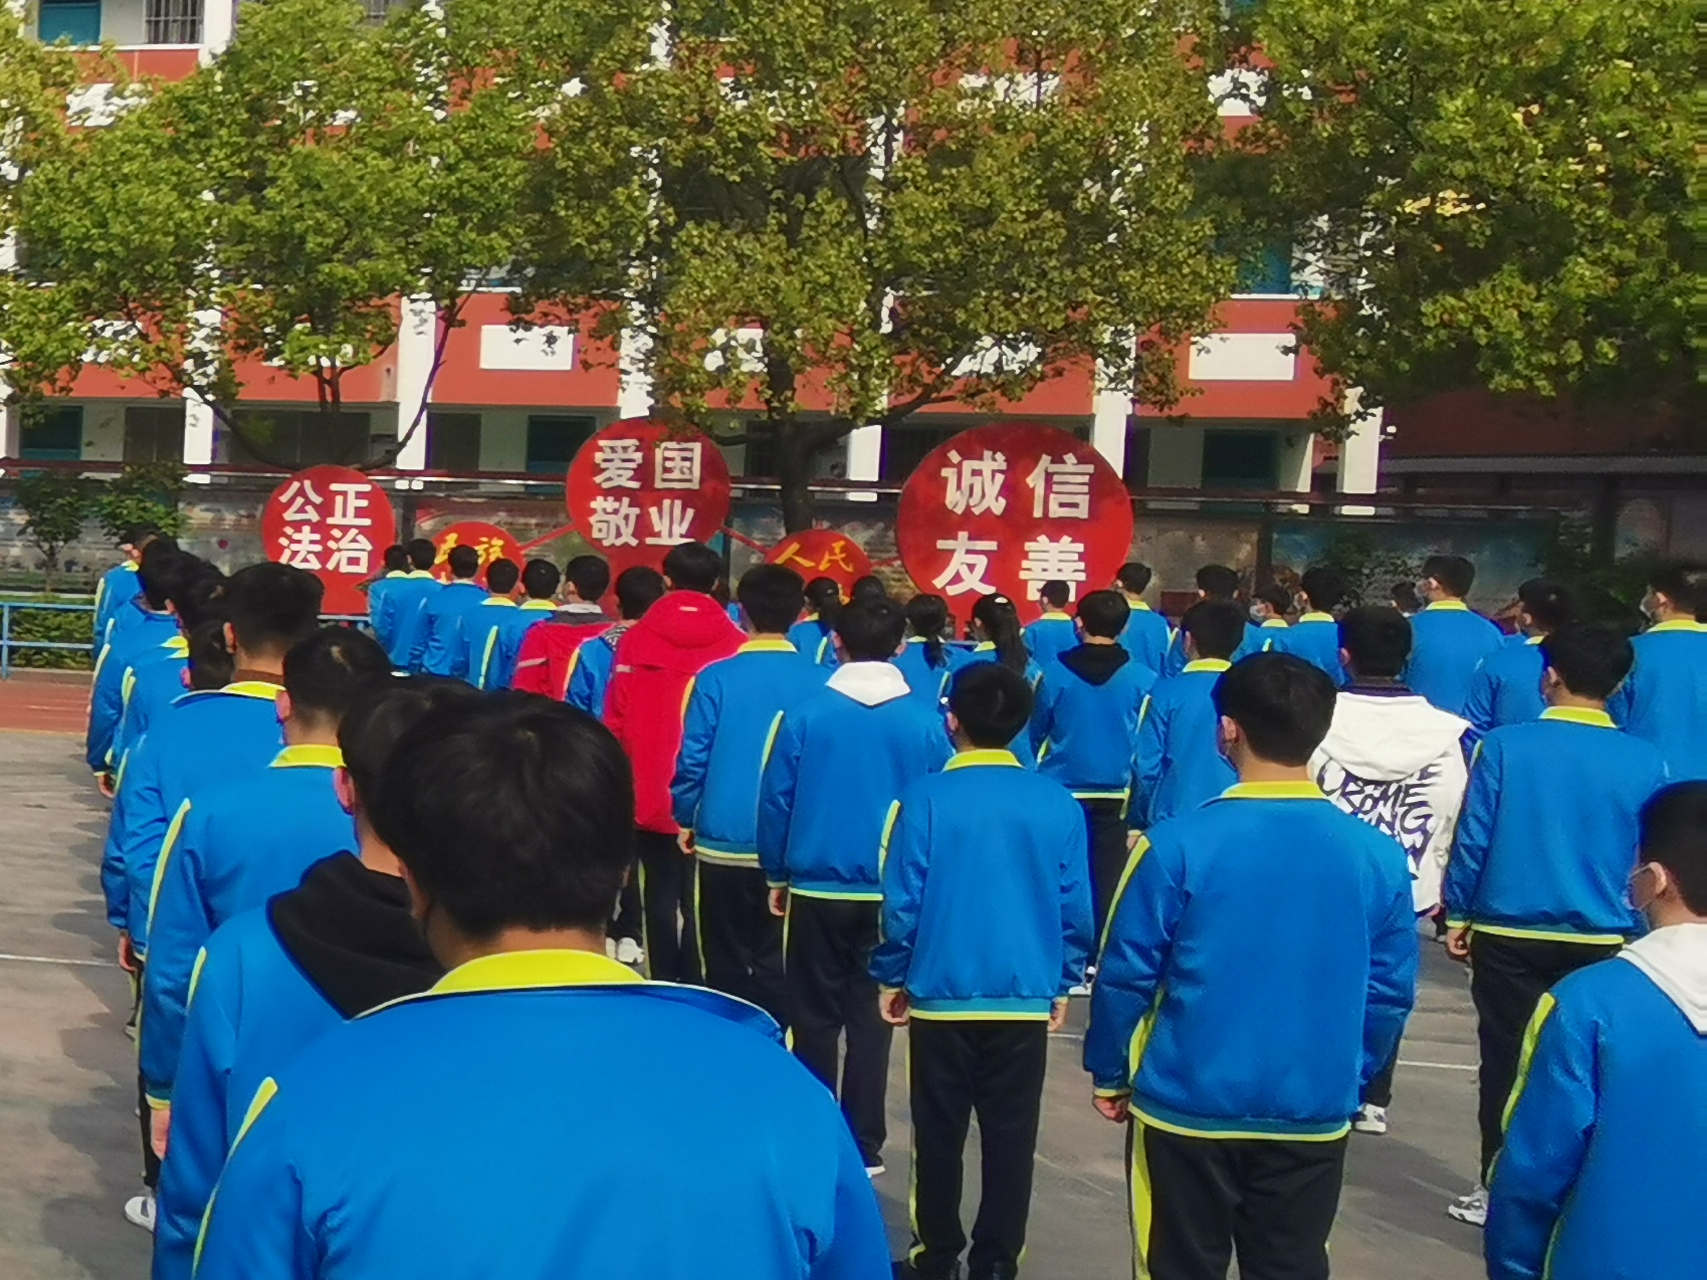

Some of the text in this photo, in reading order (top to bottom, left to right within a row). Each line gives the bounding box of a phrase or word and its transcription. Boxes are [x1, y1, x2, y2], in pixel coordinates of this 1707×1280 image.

[594, 438, 703, 490] 爱国
[941, 449, 1095, 519] 诚信
[277, 478, 373, 526] 公正
[588, 496, 696, 547] 敬业
[277, 525, 373, 574] 法治
[774, 540, 854, 573] 人民
[932, 531, 1087, 602] 友善
